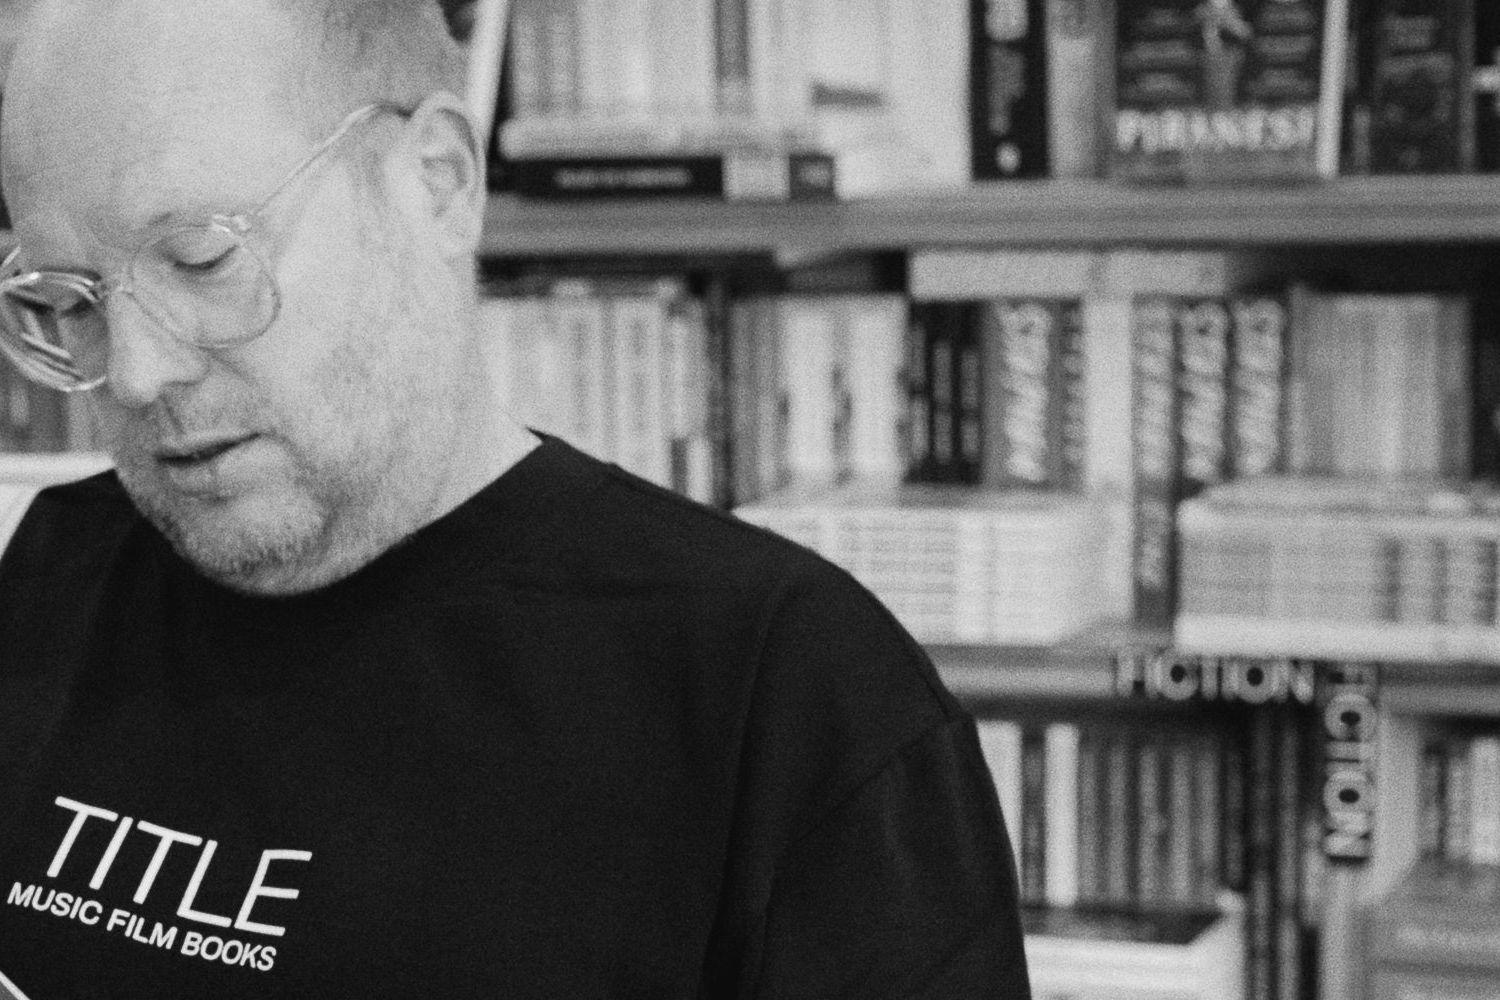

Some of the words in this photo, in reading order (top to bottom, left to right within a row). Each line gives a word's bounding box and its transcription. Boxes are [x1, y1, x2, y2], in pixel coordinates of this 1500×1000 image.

[1117, 647, 1314, 704] FICTION
[46, 796, 313, 936] TITLE
[7, 882, 103, 925] MUSIC
[107, 908, 177, 949] FILM
[180, 932, 277, 971] BOOKS
